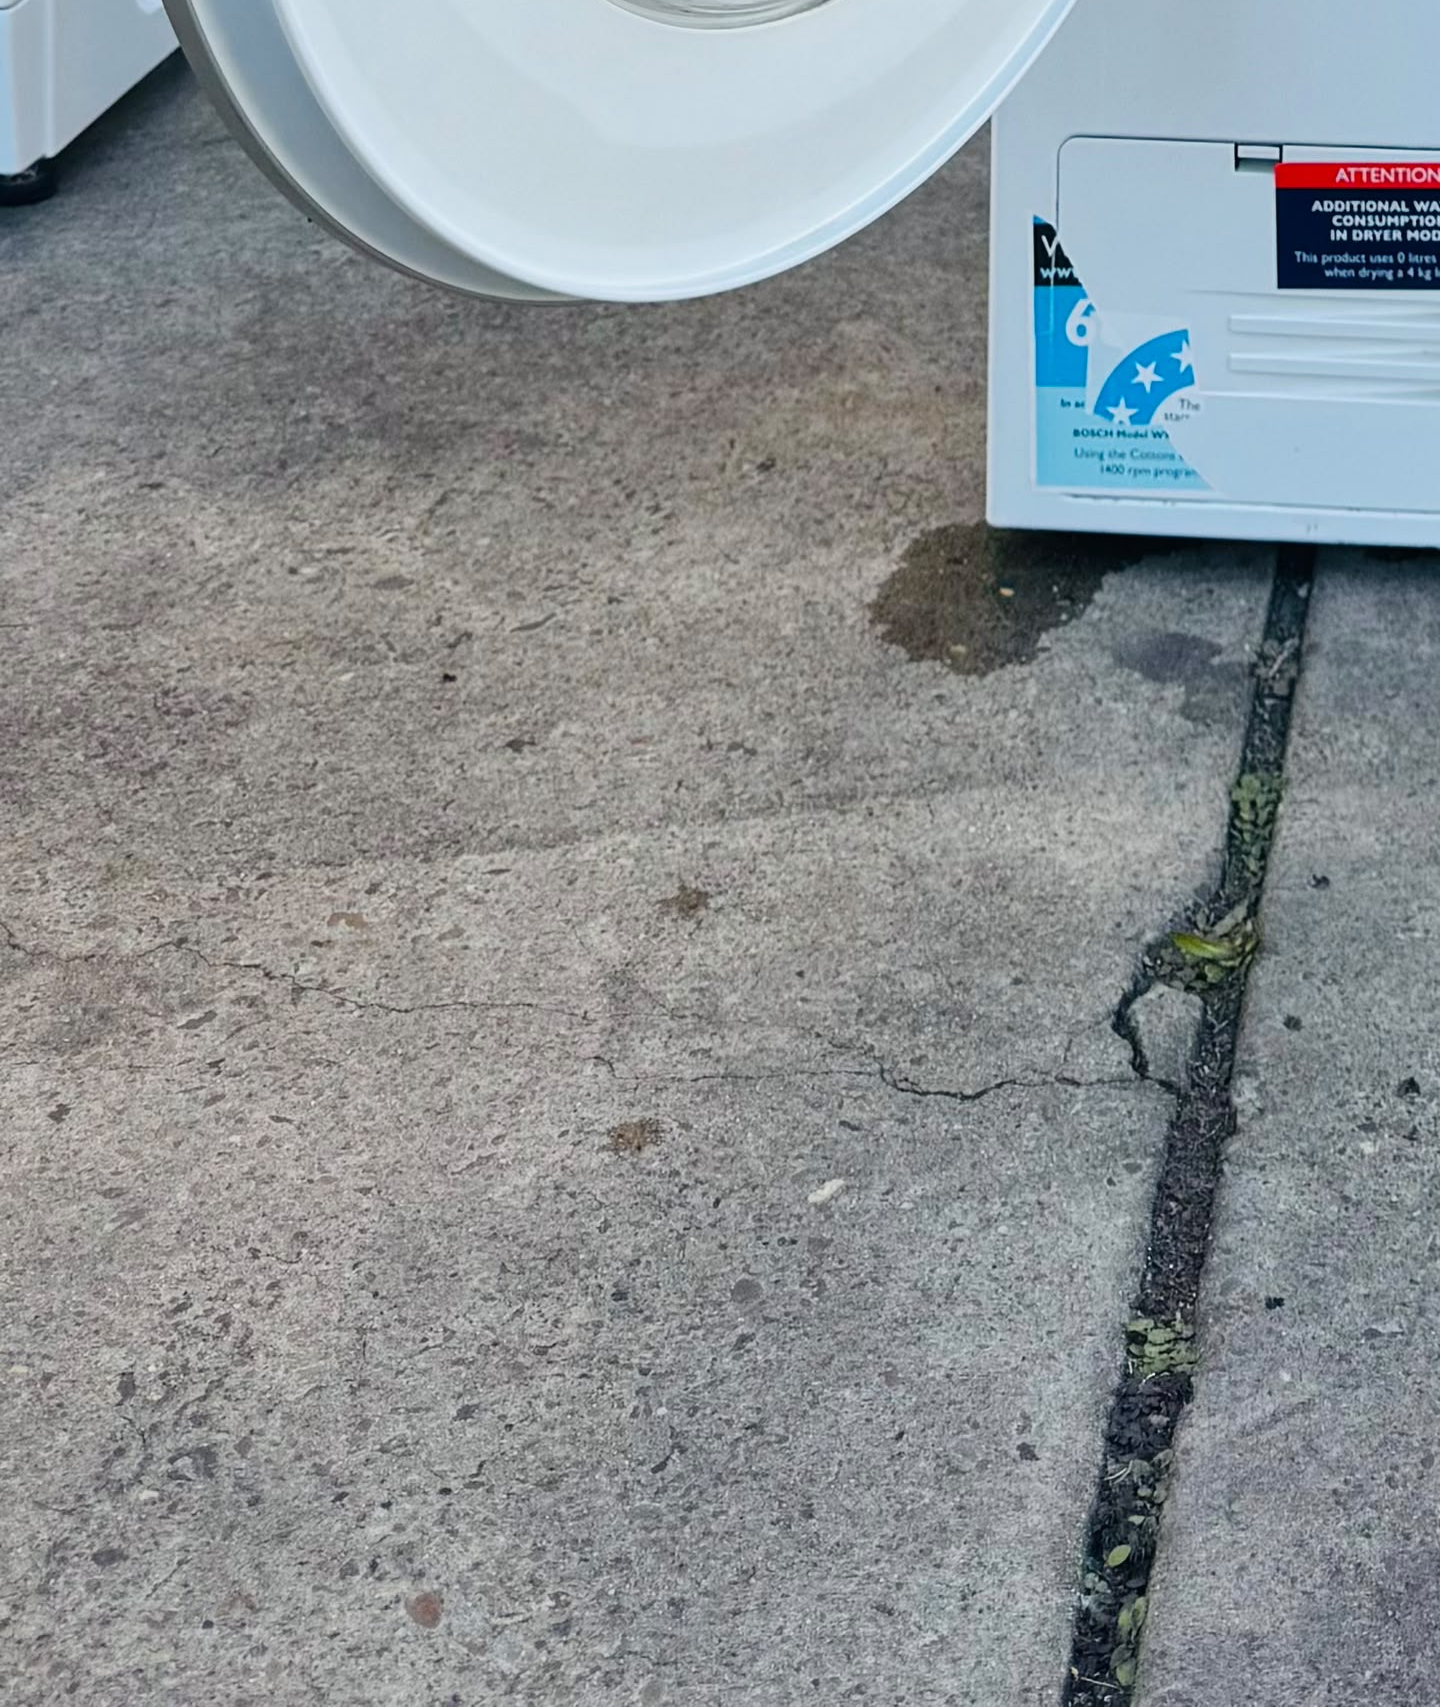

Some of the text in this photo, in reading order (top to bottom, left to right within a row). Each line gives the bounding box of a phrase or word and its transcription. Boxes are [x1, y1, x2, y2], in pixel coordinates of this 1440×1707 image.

[1311, 200, 1410, 213] ADDITIONAL
[1330, 229, 1347, 241] IN
[1352, 229, 1402, 242] DRYER
[1294, 251, 1318, 264] This
[1321, 251, 1366, 265] product
[1369, 254, 1394, 264] uses
[1408, 252, 1437, 264] litres
[1324, 266, 1355, 278] when
[1358, 267, 1394, 281] drying
[1397, 269, 1404, 278] a
[1406, 267, 1415, 278] 4
[1418, 267, 1432, 281] kg
[1178, 398, 1200, 411] The
[1073, 428, 1114, 438] BOSCH
[1116, 428, 1148, 438] Model
[1074, 447, 1105, 461] Using
[1108, 448, 1126, 459] the
[1100, 464, 1125, 475] 1400
[1127, 467, 1152, 478] rpm
